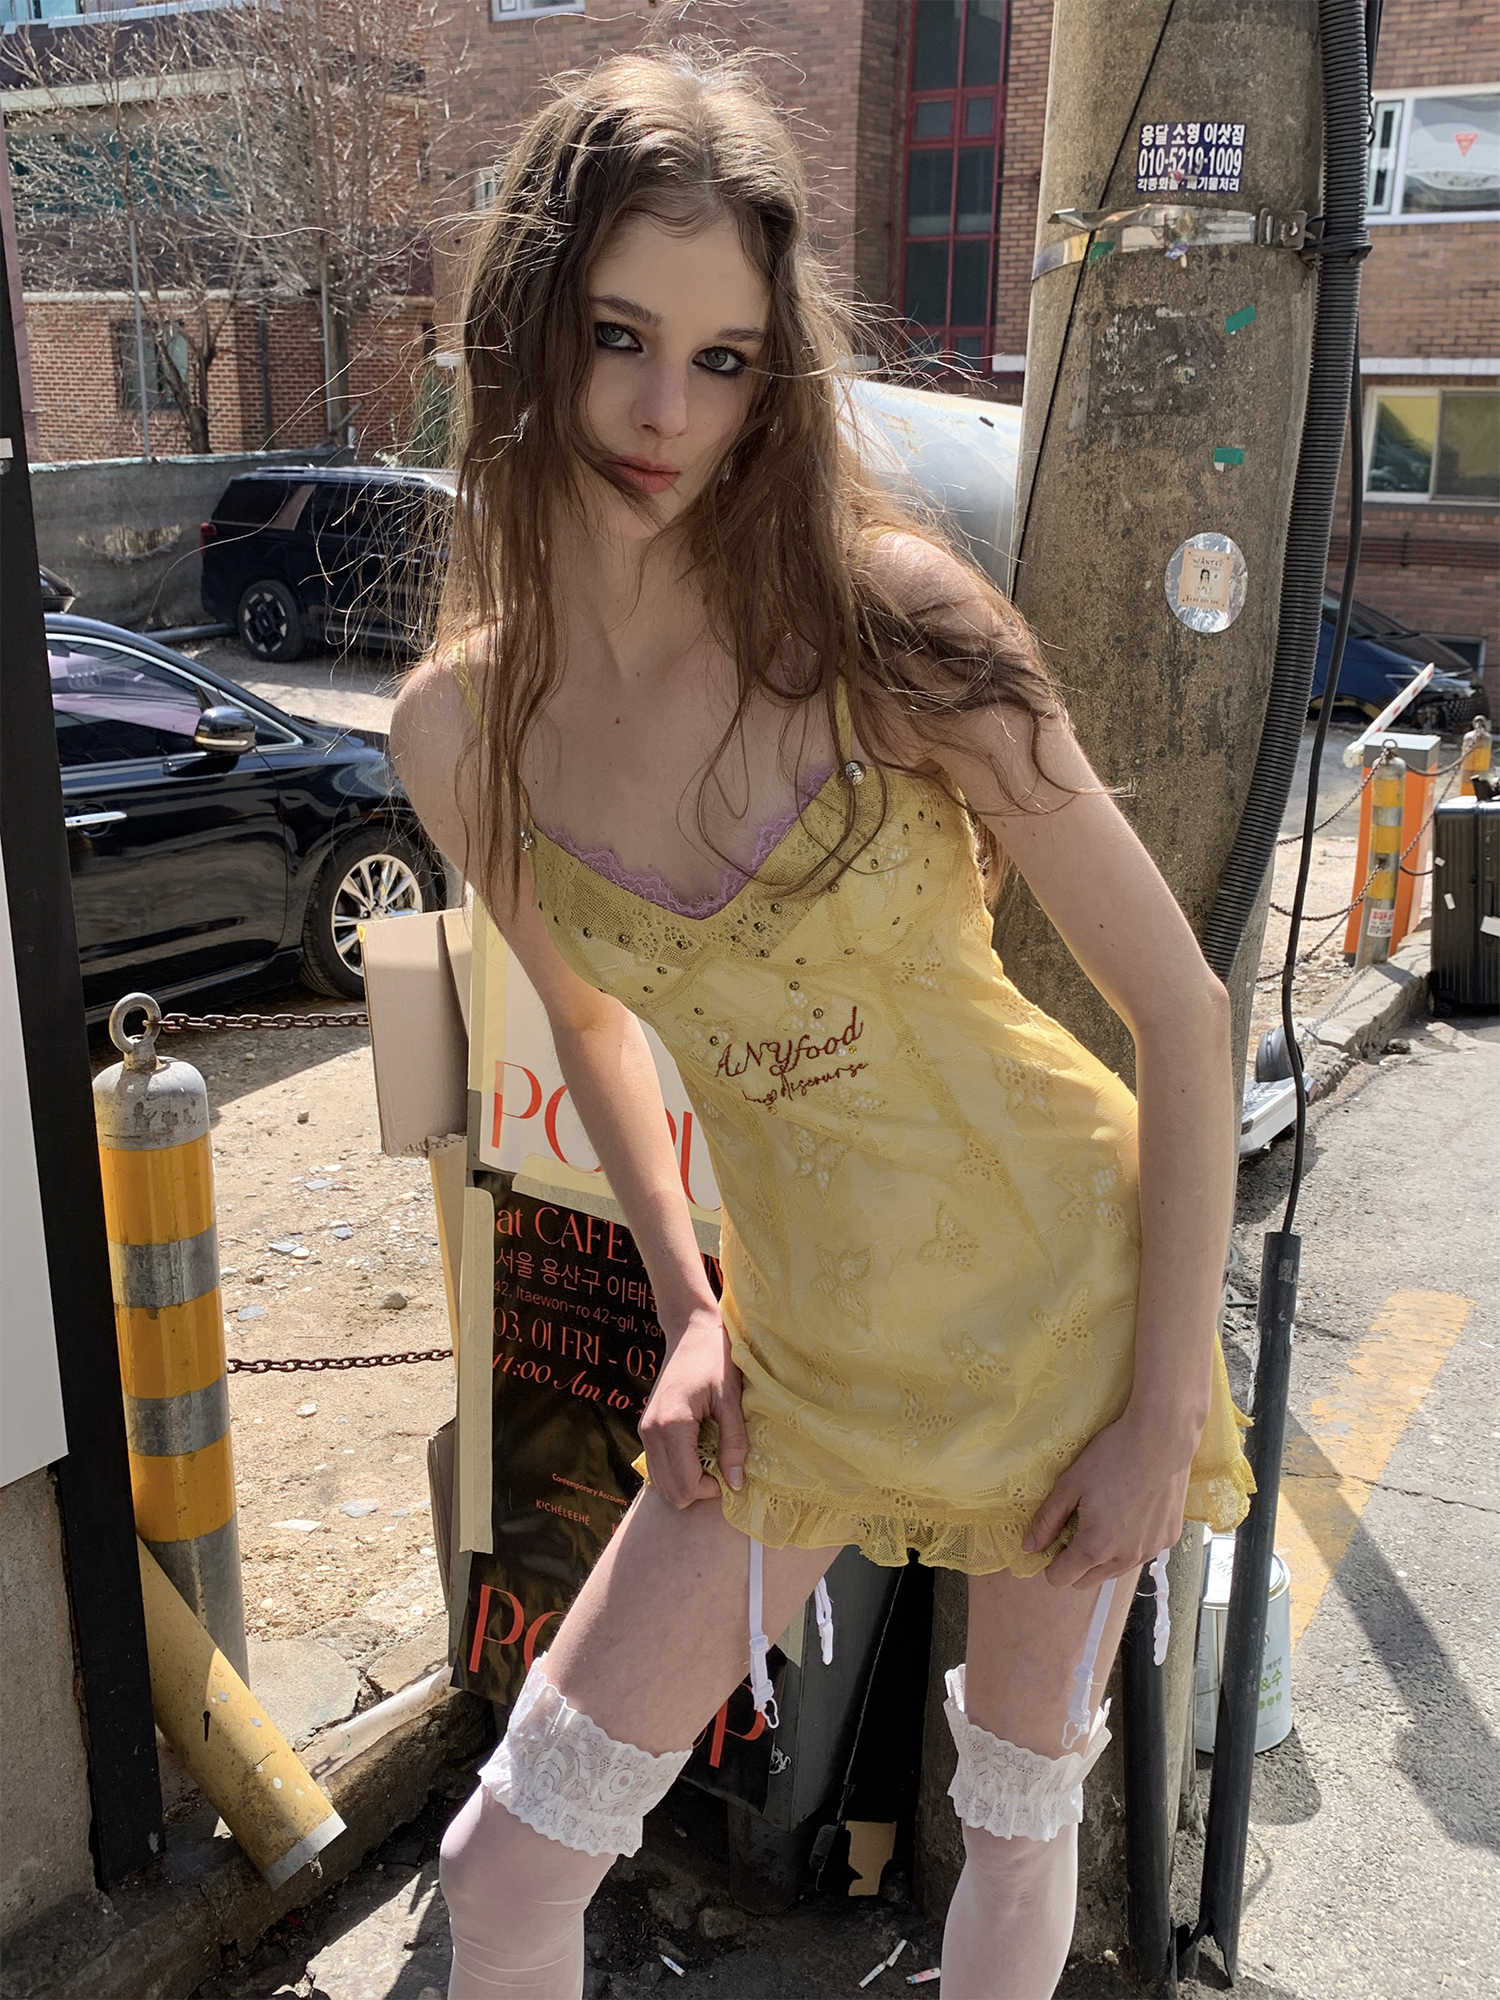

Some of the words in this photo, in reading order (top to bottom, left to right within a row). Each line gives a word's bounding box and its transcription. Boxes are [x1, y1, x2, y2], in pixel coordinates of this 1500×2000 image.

[1141, 125, 1169, 146] 용달
[1171, 123, 1200, 144] 소형
[1204, 123, 1245, 146] 이삿짐
[495, 1208, 524, 1238] at
[534, 1206, 629, 1263] CAFE
[495, 1247, 536, 1279] 서울
[539, 1258, 601, 1296] 용산구
[516, 1284, 591, 1318] Itaewon-ro
[560, 1326, 600, 1366] FRI
[607, 1388, 631, 1410] to
